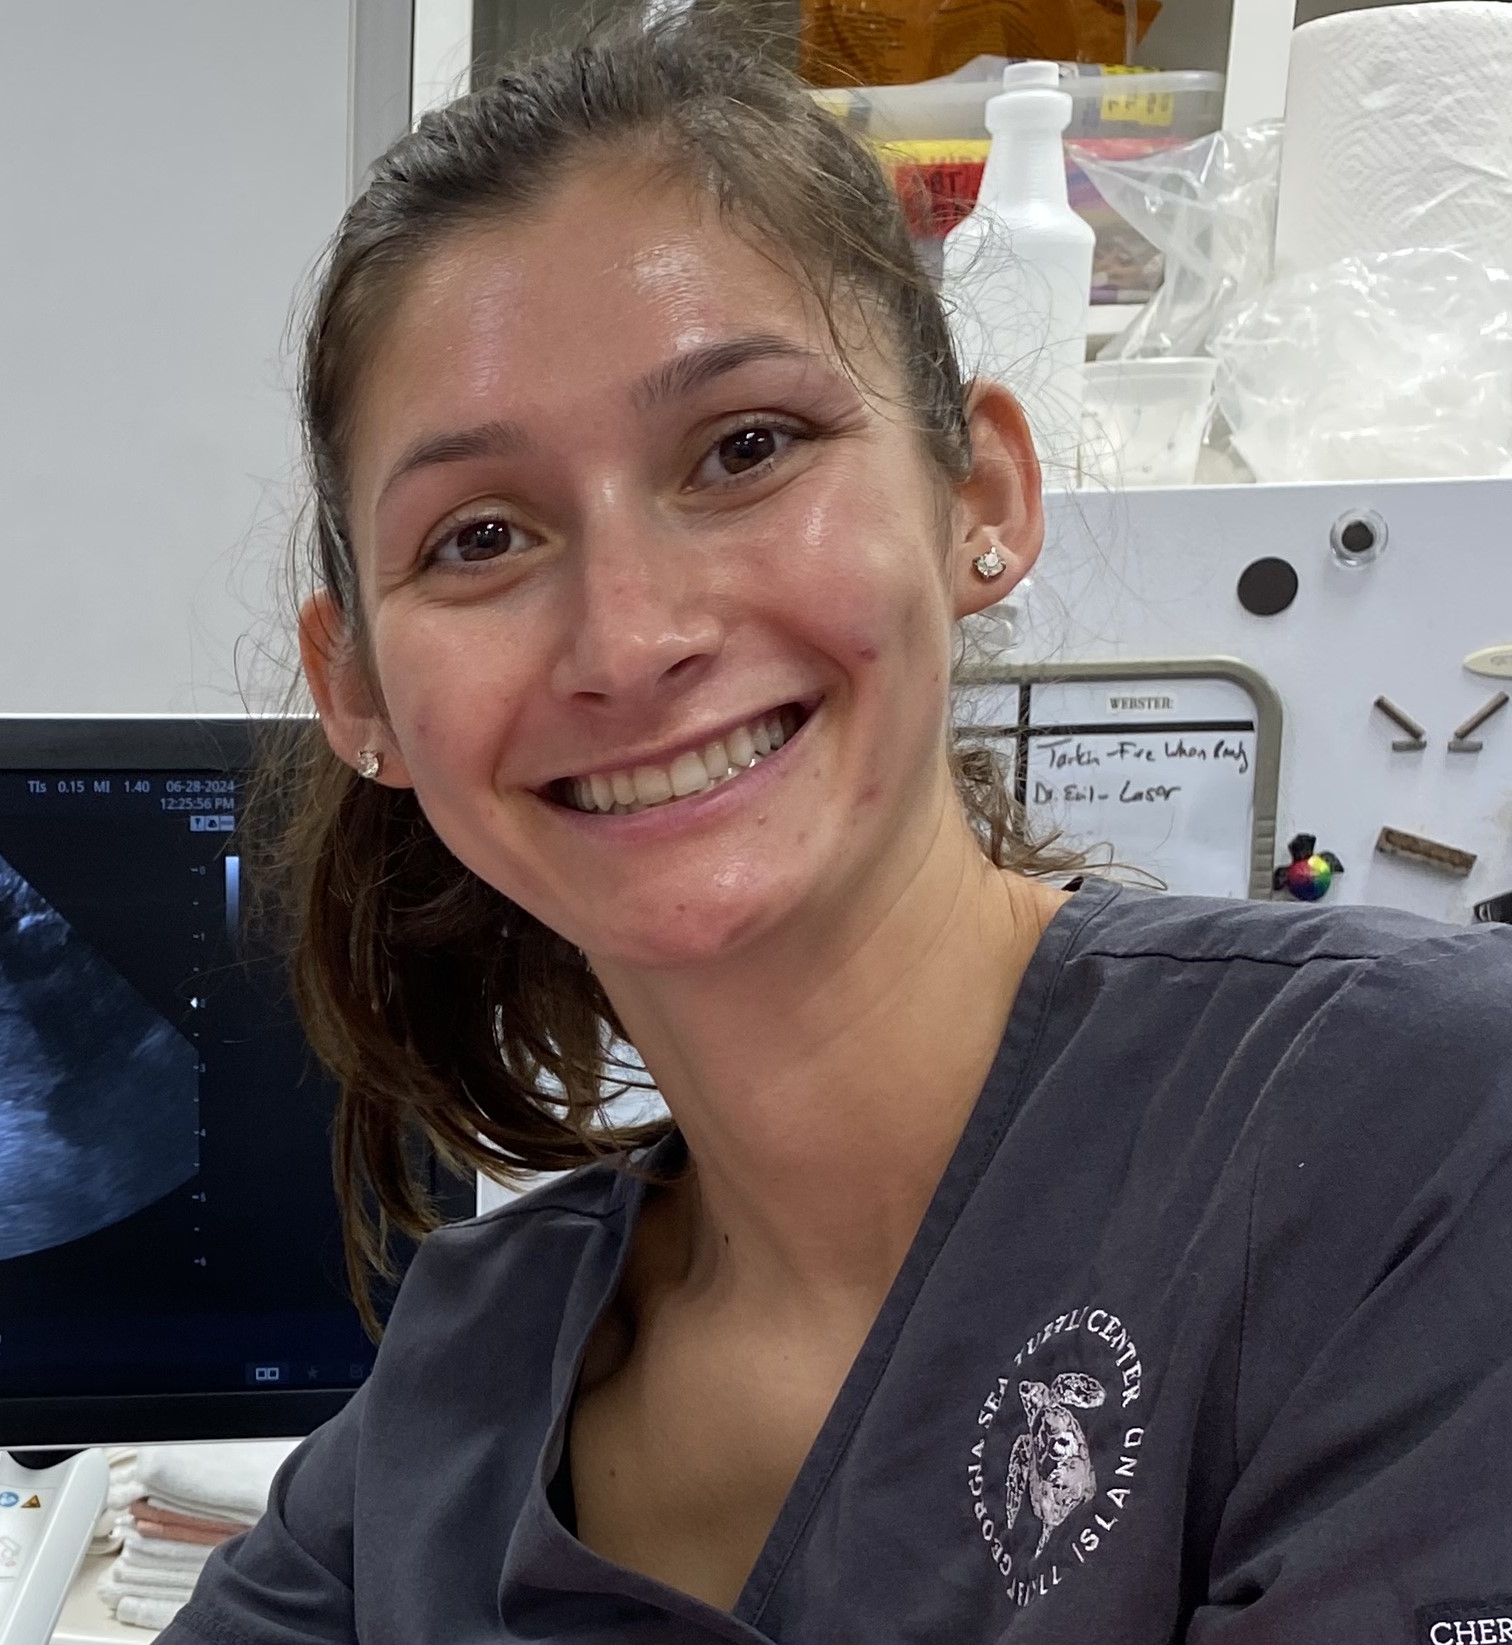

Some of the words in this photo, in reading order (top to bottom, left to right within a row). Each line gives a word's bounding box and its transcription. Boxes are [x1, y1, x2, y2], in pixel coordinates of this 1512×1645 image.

[1164, 738, 1206, 761] When
[57, 780, 85, 793] 0.15
[93, 780, 111, 793] MI
[124, 780, 150, 793] 1.40
[165, 780, 234, 793] 06-28-2024
[1119, 780, 1181, 803] Laser
[160, 798, 212, 810] 12:25:56
[214, 798, 234, 810] PM
[1087, 1308, 1143, 1408] CENTER
[1071, 1426, 1145, 1564] ISLAND
